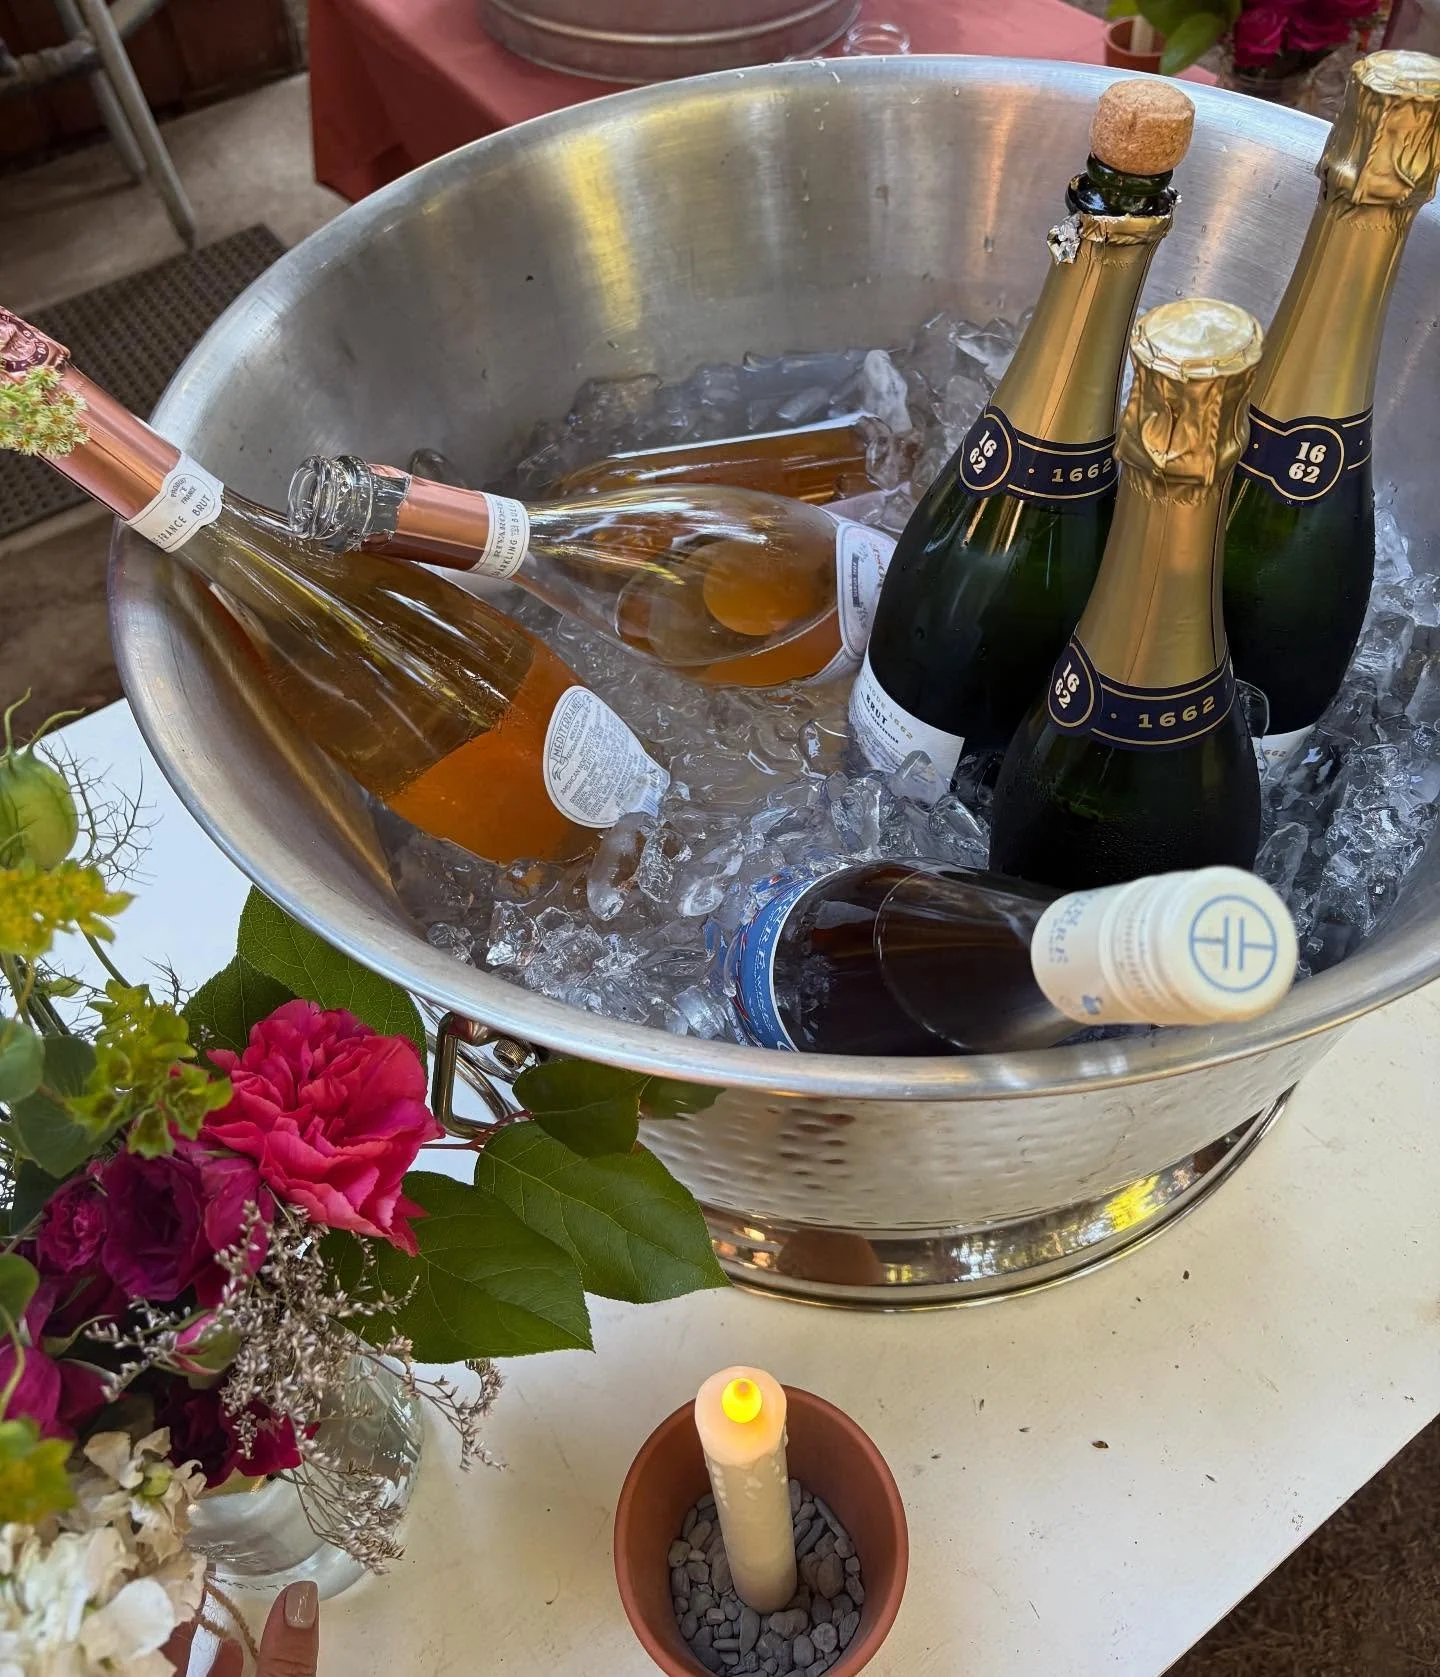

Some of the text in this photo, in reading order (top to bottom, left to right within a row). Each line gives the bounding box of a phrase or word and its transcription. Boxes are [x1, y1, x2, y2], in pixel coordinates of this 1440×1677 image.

[979, 430, 997, 457] 16
[1295, 442, 1327, 464] 16
[969, 447, 987, 475] 62
[1051, 457, 1113, 483] 1662
[1288, 462, 1321, 484] 62
[159, 515, 187, 541] FRANCE
[192, 494, 211, 517] BRUT
[1062, 661, 1080, 693] 16
[1054, 678, 1071, 709] 62
[866, 694, 888, 725] BRUT
[1138, 695, 1215, 728] 1662
